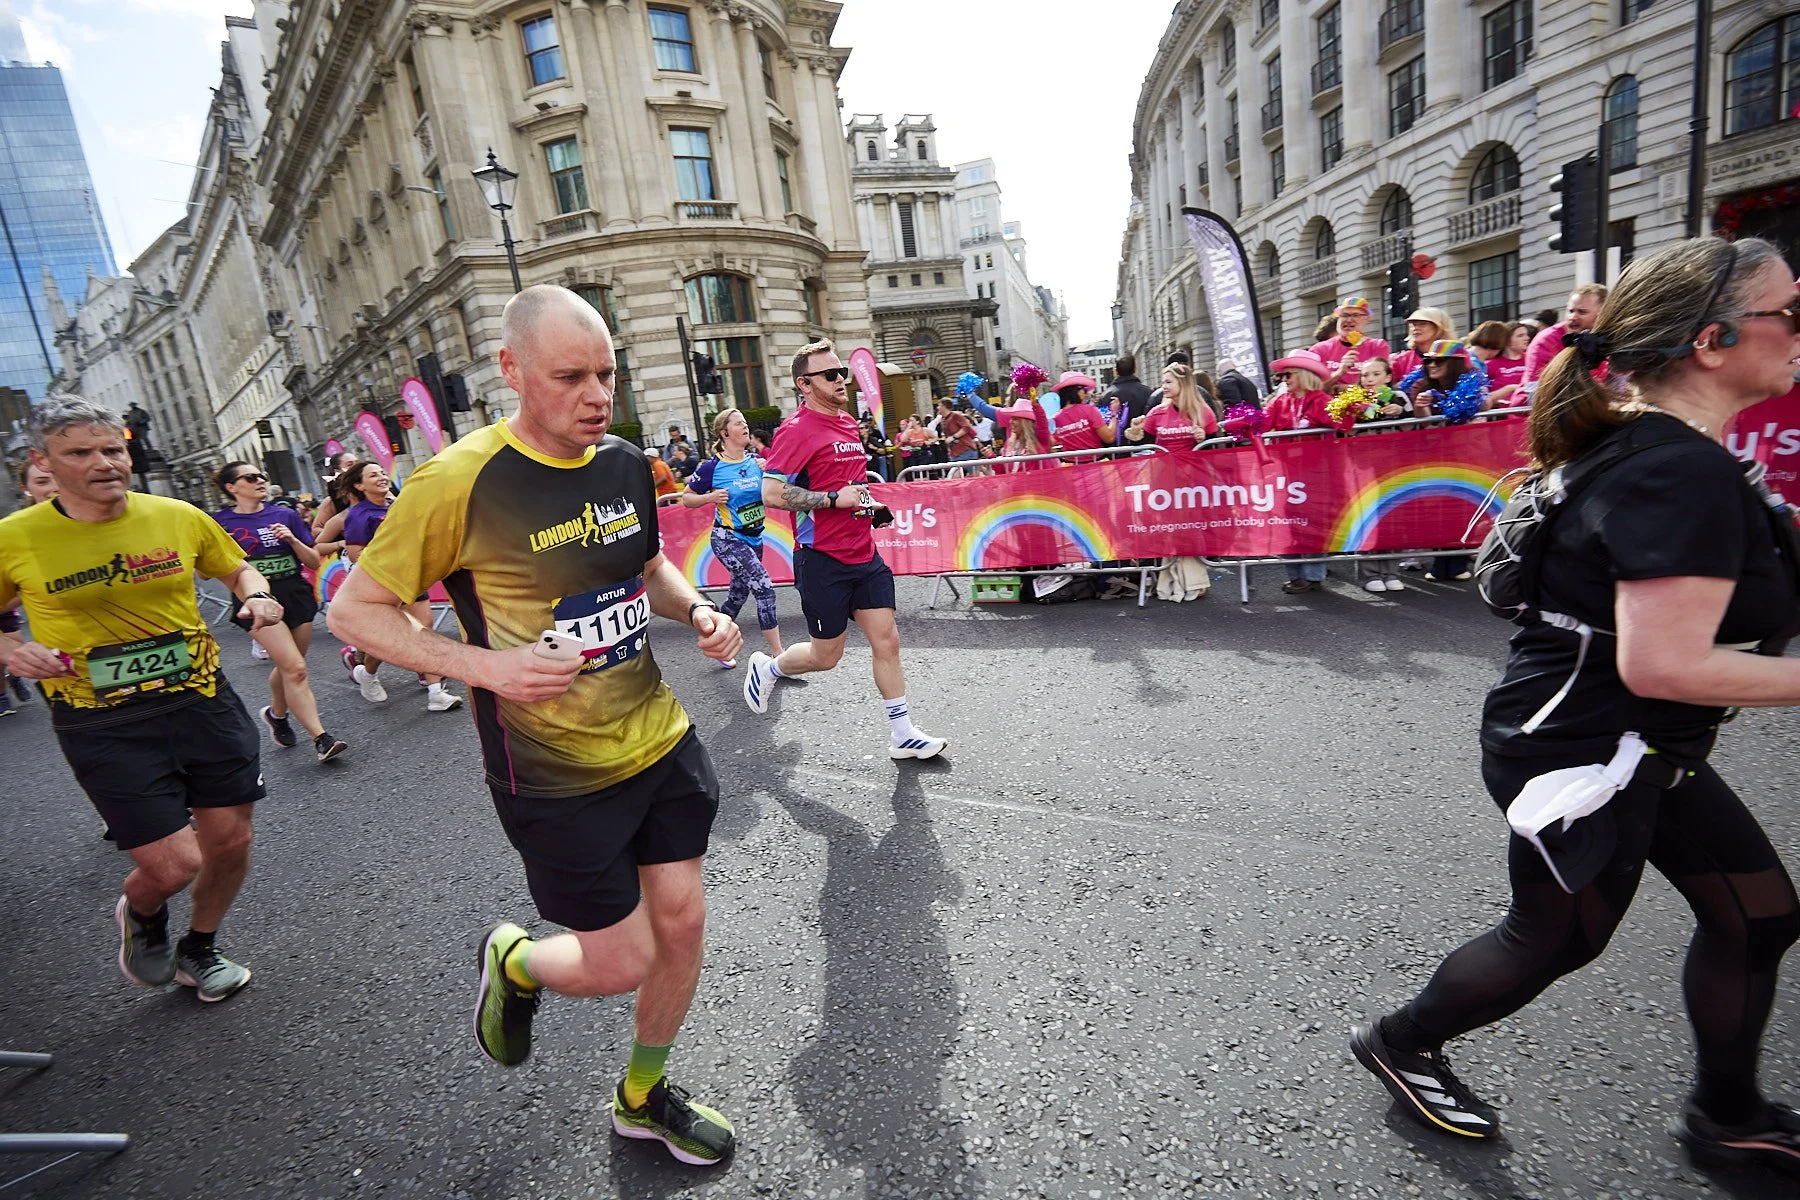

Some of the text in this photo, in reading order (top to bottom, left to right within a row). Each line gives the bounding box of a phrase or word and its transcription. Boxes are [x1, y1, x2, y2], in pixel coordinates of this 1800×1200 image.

[1711, 150, 1787, 176] LOMBARD
[1762, 470, 1798, 482] arity
[1124, 476, 1308, 513] Tommy's
[600, 513, 640, 536] LANDMARKS
[743, 508, 763, 522] 6041
[1128, 515, 1309, 534] The pregnancy and baby charity
[529, 516, 585, 553] LONDON
[602, 533, 618, 546] HALF
[885, 539, 908, 549] baby
[908, 538, 939, 548] charity
[130, 558, 183, 577] LANDMARKS
[256, 558, 291, 573] 6472
[45, 564, 110, 594] LONDON
[596, 587, 626, 604] ARTUR
[567, 598, 648, 643] 11102
[121, 640, 157, 653] MARCO
[105, 649, 179, 681] 7424
